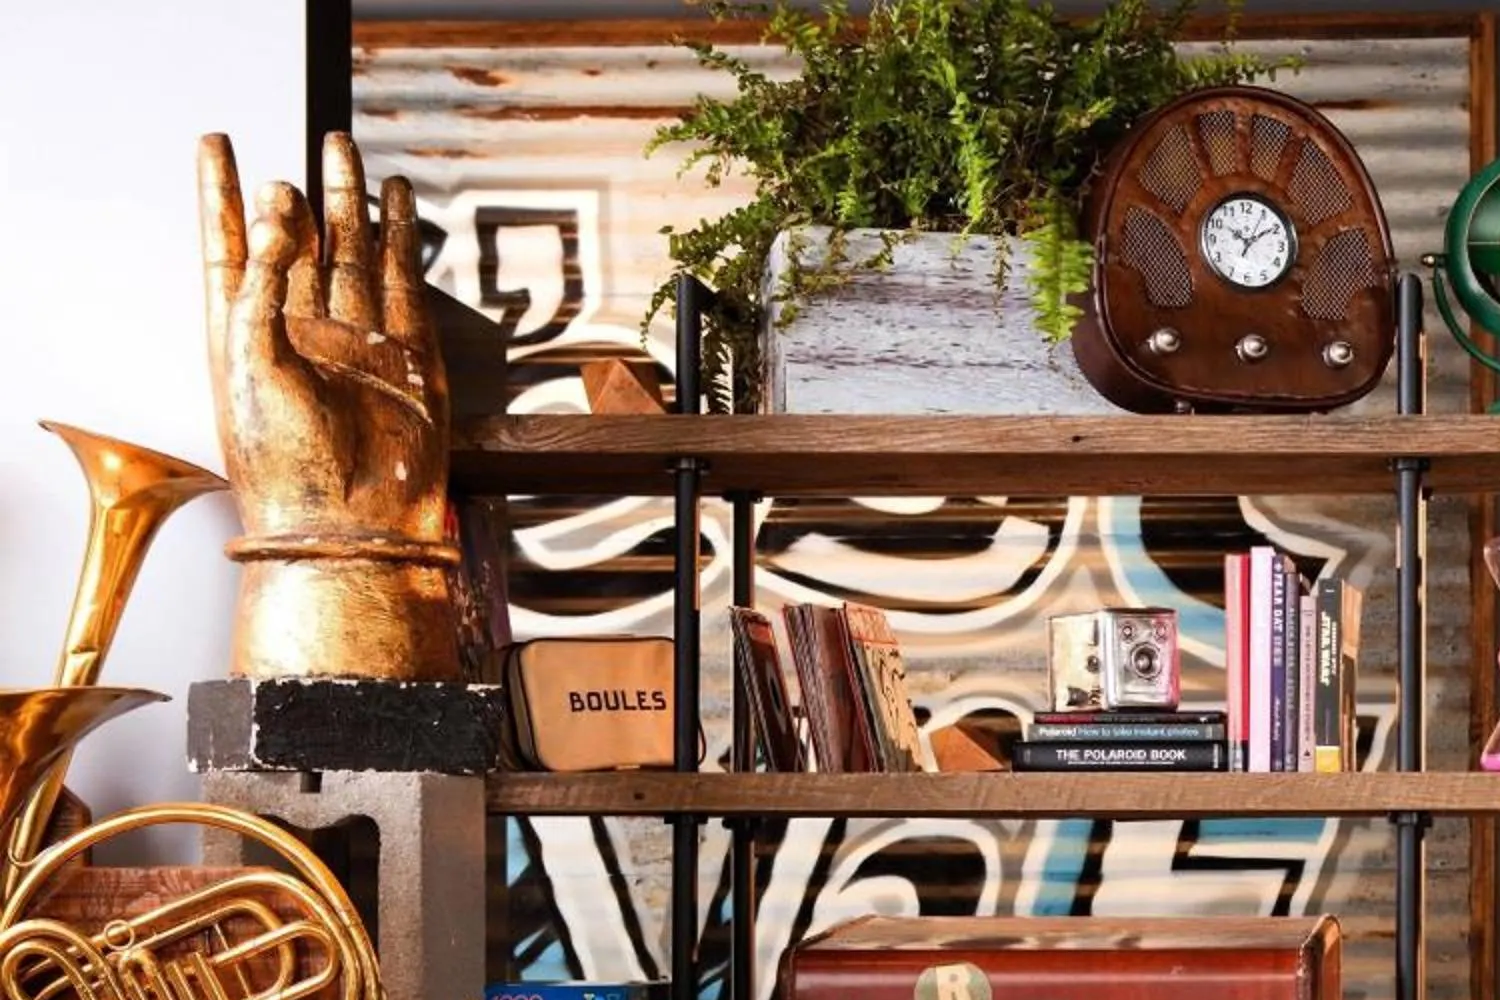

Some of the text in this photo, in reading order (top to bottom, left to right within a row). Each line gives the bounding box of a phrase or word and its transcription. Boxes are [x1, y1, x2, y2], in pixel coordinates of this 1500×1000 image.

[1223, 206, 1235, 217] 11
[1240, 202, 1253, 214] 12
[1210, 218, 1223, 229] 10
[1272, 223, 1280, 235] 2
[1210, 233, 1217, 245] 9
[1278, 241, 1285, 253] 3
[1228, 266, 1235, 277] 7
[1260, 270, 1268, 281] 5
[1319, 611, 1331, 686] STAR WARS
[569, 690, 666, 714] BOULES
[1038, 726, 1076, 737] Polaroid
[1078, 727, 1098, 737] How
[1101, 727, 1111, 737] to
[1056, 749, 1187, 761] THE POLAROID BOOK
